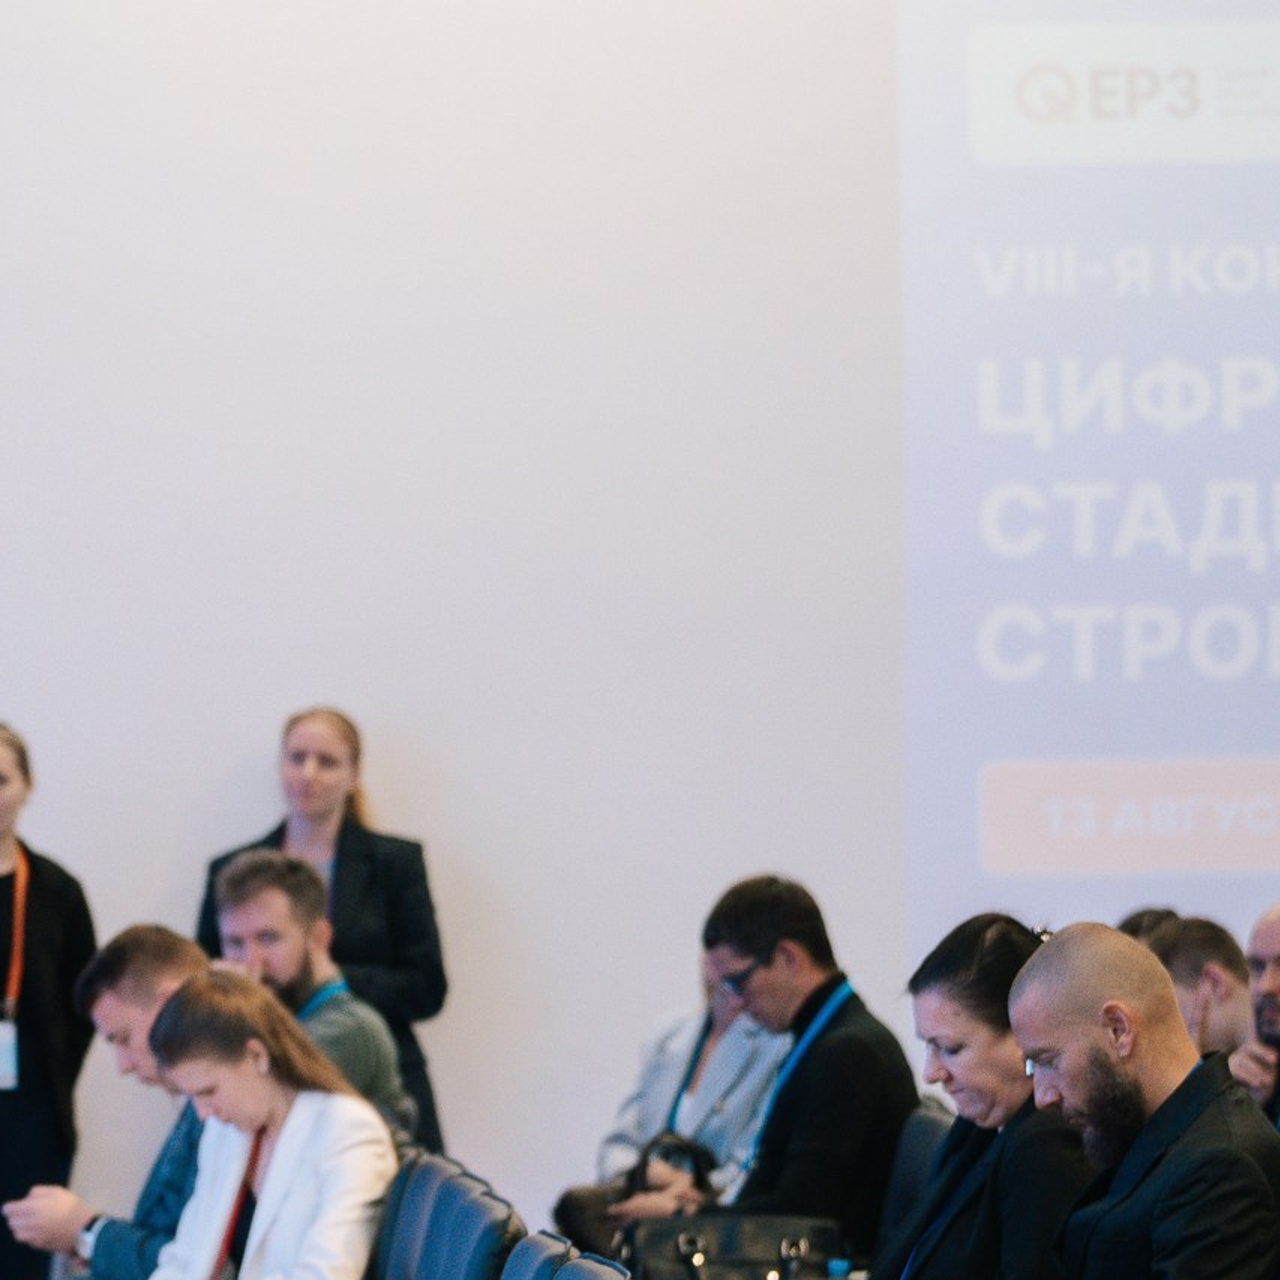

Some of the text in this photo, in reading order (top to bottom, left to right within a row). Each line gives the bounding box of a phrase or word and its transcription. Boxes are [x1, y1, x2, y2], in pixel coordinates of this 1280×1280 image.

[977, 353, 1280, 452] ЦИФР
[976, 478, 1280, 575] СТАД
[975, 604, 1280, 683] СТРО
